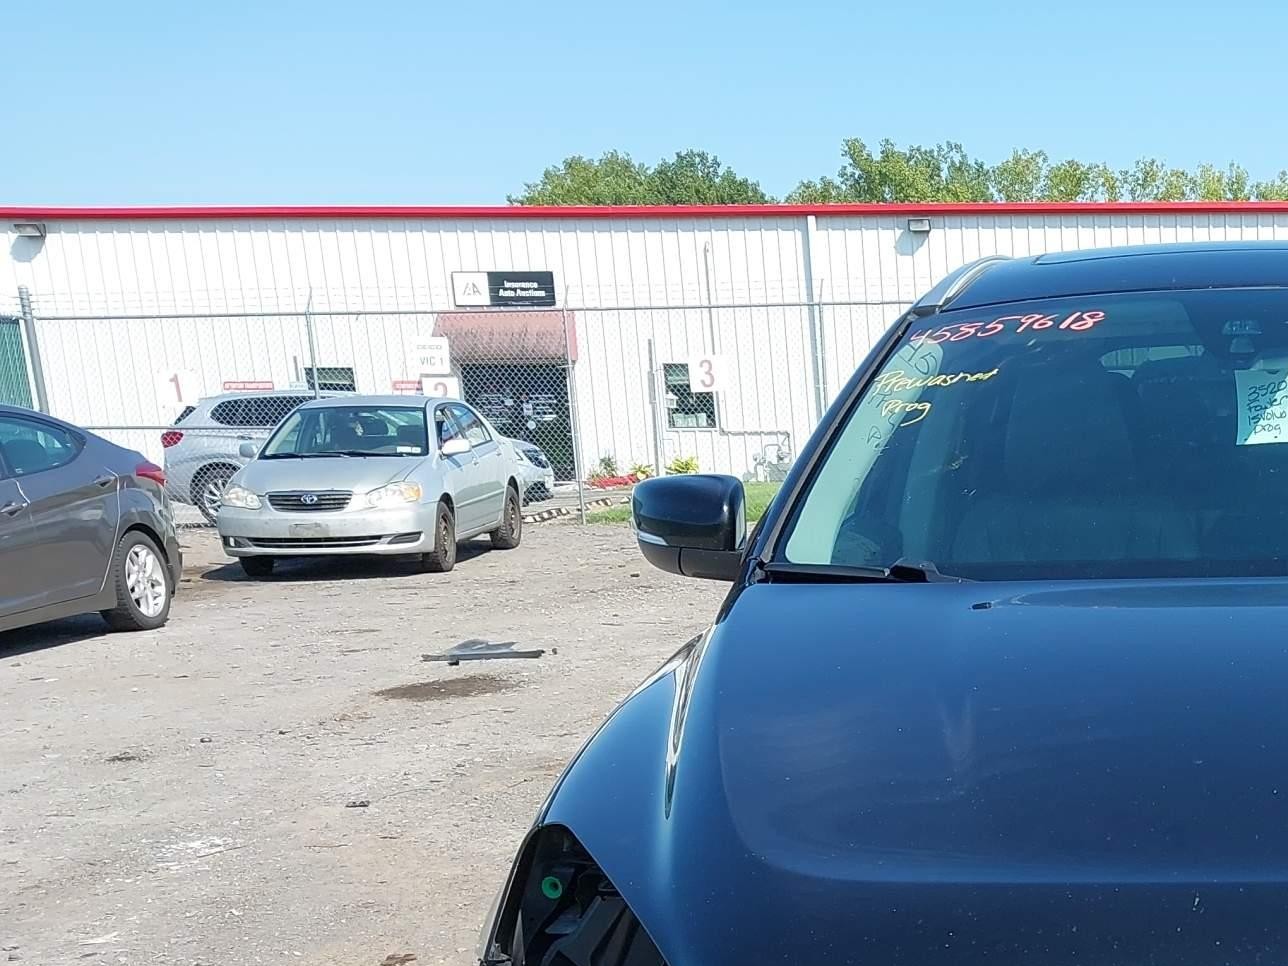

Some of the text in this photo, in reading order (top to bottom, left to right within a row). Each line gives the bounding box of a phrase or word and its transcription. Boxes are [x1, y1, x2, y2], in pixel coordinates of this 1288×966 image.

[910, 311, 1105, 344] 45859618
[169, 373, 183, 403] 1
[699, 359, 715, 388] 3
